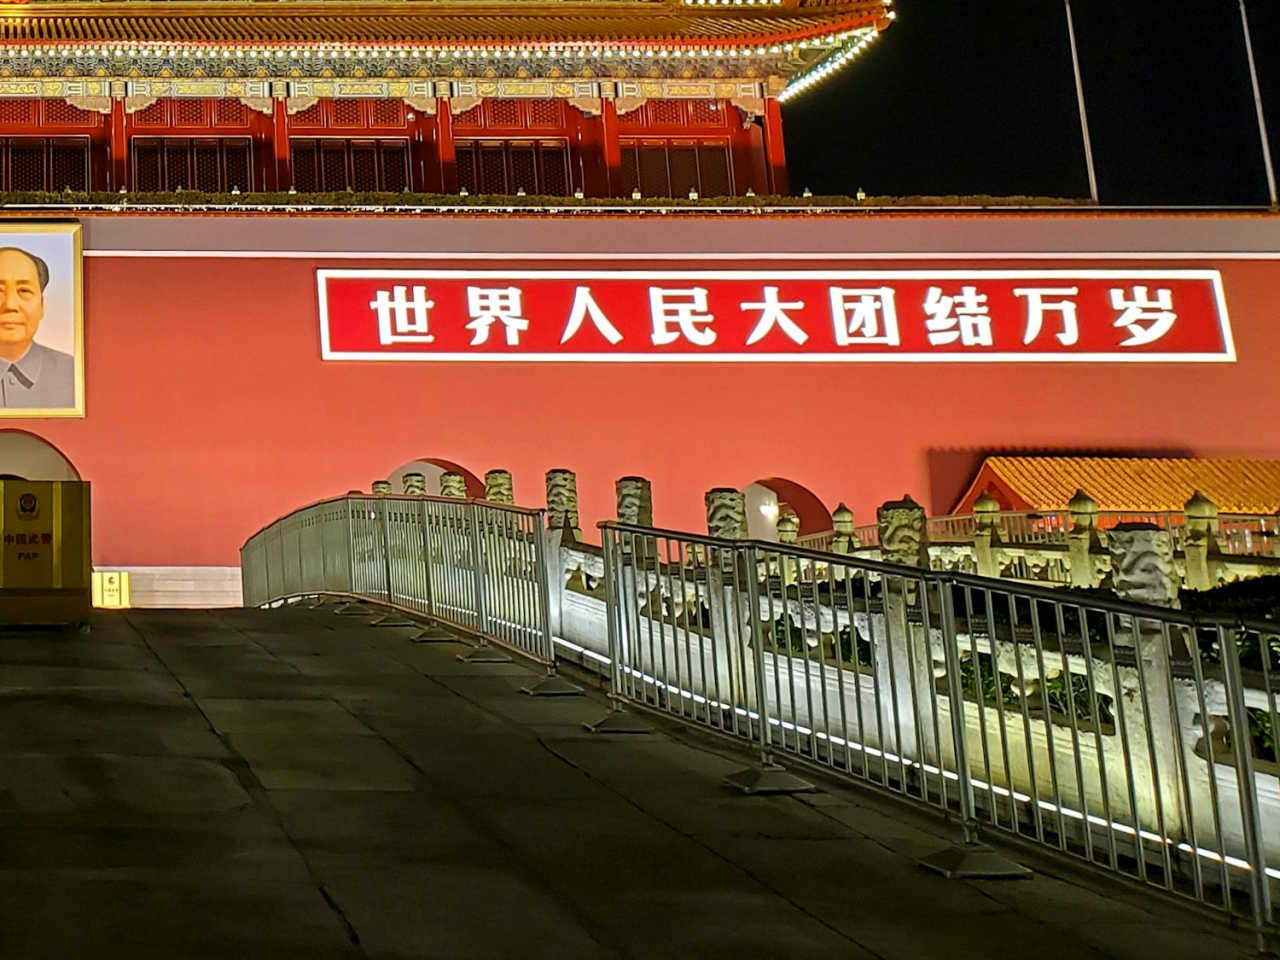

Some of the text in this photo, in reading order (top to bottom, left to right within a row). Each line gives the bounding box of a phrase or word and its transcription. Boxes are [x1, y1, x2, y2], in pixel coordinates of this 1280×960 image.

[369, 285, 1178, 346] 世界人民大团结万岁
[4, 533, 52, 545] 中国武警
[17, 552, 39, 560] PAP
